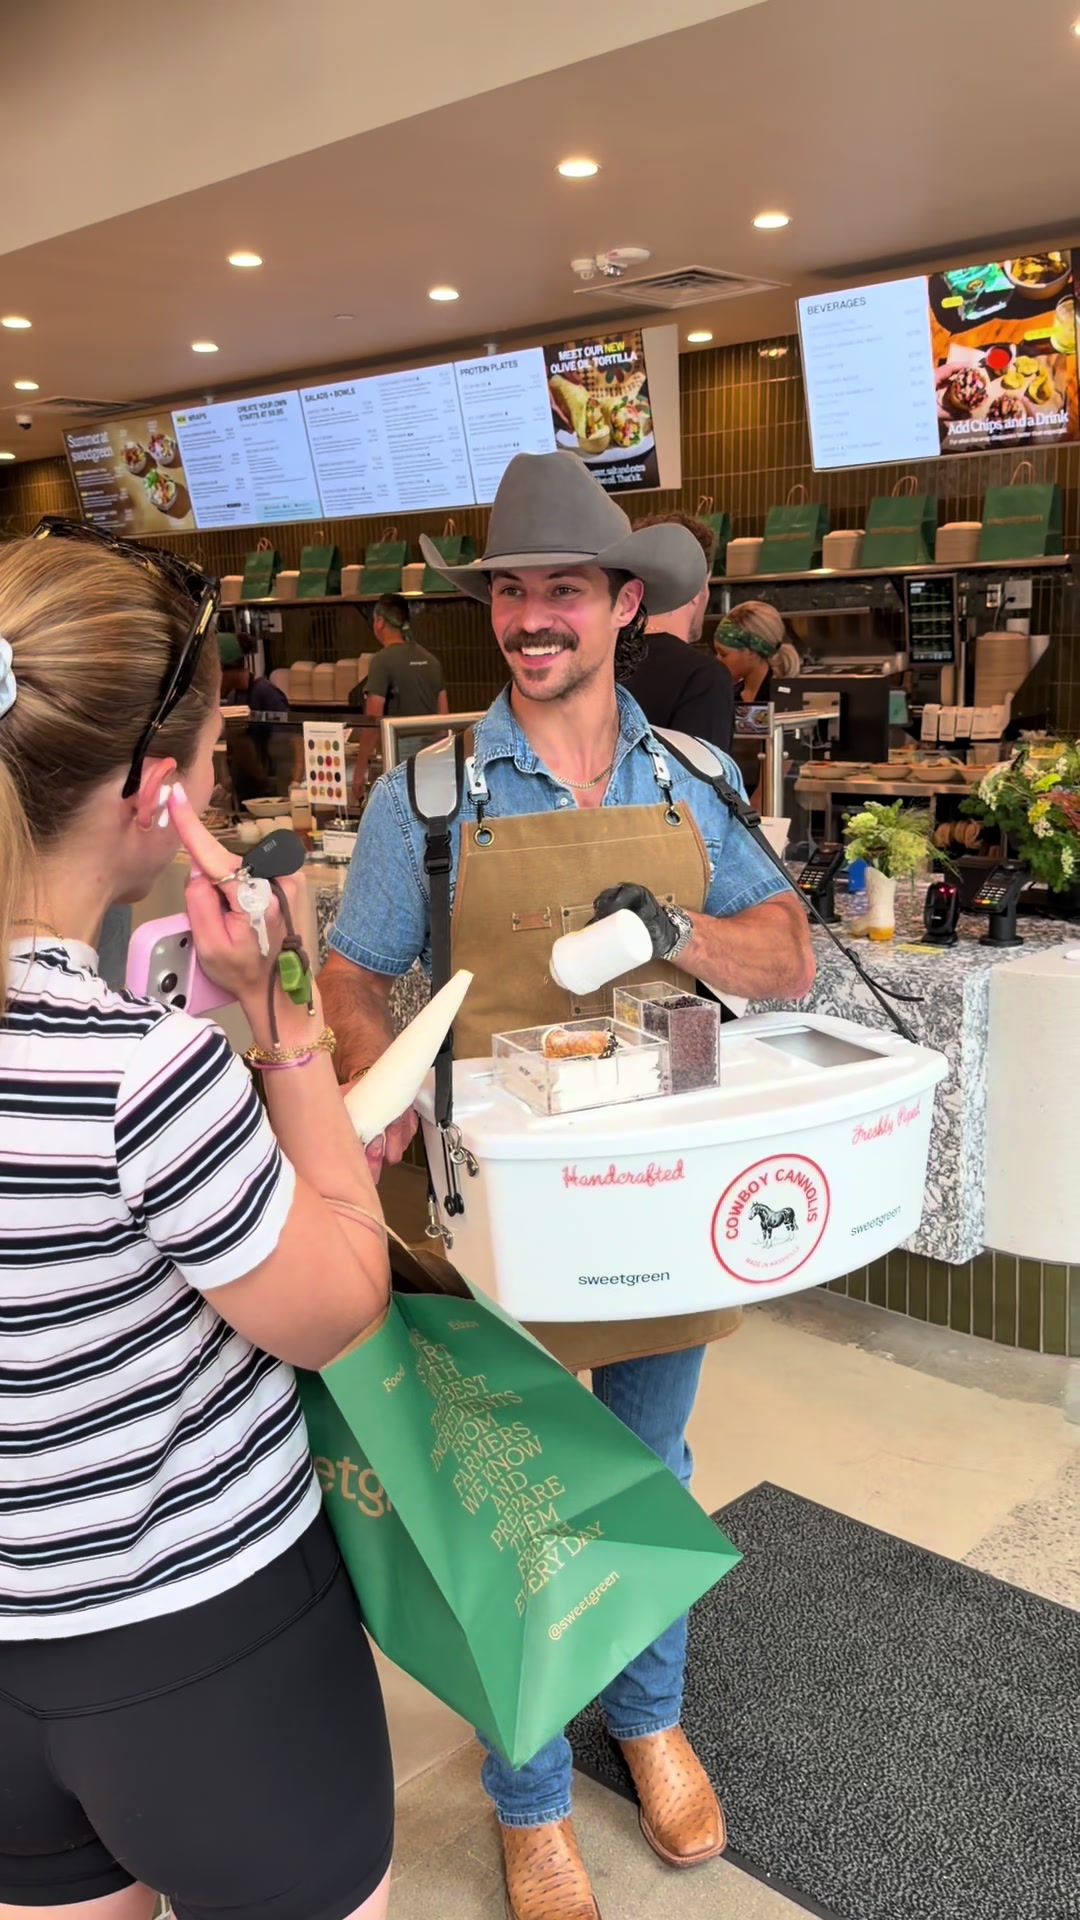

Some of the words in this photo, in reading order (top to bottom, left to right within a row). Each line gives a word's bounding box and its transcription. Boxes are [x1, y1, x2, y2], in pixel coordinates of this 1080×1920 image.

[807, 297, 867, 315] BEVERAGES
[550, 361, 576, 374] OLIVE
[577, 359, 592, 370] OIL
[594, 351, 638, 367] TORTILLA
[558, 348, 582, 361] MEET
[584, 345, 603, 357] OUR
[604, 341, 625, 354] NEW
[460, 365, 490, 376] PROTEIN
[491, 360, 518, 371] PLATES
[304, 391, 329, 402] SALADS
[334, 387, 356, 398] BOWLS
[947, 420, 970, 435] Add
[970, 418, 1002, 434] Chips
[1004, 416, 1026, 429] and
[1027, 418, 1035, 426] a
[1035, 409, 1069, 426] Drink
[562, 1159, 685, 1188] Handcrafted
[725, 1172, 769, 1240] COWBOY
[775, 1168, 818, 1223] CANNOLIS
[850, 1206, 901, 1236] sweetgreen
[578, 1270, 670, 1286] sweetgreen
[382, 1363, 406, 1392] Food
[441, 1374, 488, 1403] BEST
[451, 1412, 499, 1463] FROM
[453, 1421, 531, 1498] FARMERS
[461, 1478, 489, 1516] WE
[481, 1434, 543, 1487] KNOW
[490, 1471, 528, 1515] AND
[490, 1475, 567, 1552] PREPARE
[510, 1501, 561, 1556] THEM
[560, 1520, 606, 1558] DAY
[548, 1570, 620, 1641] @sweetgreen
